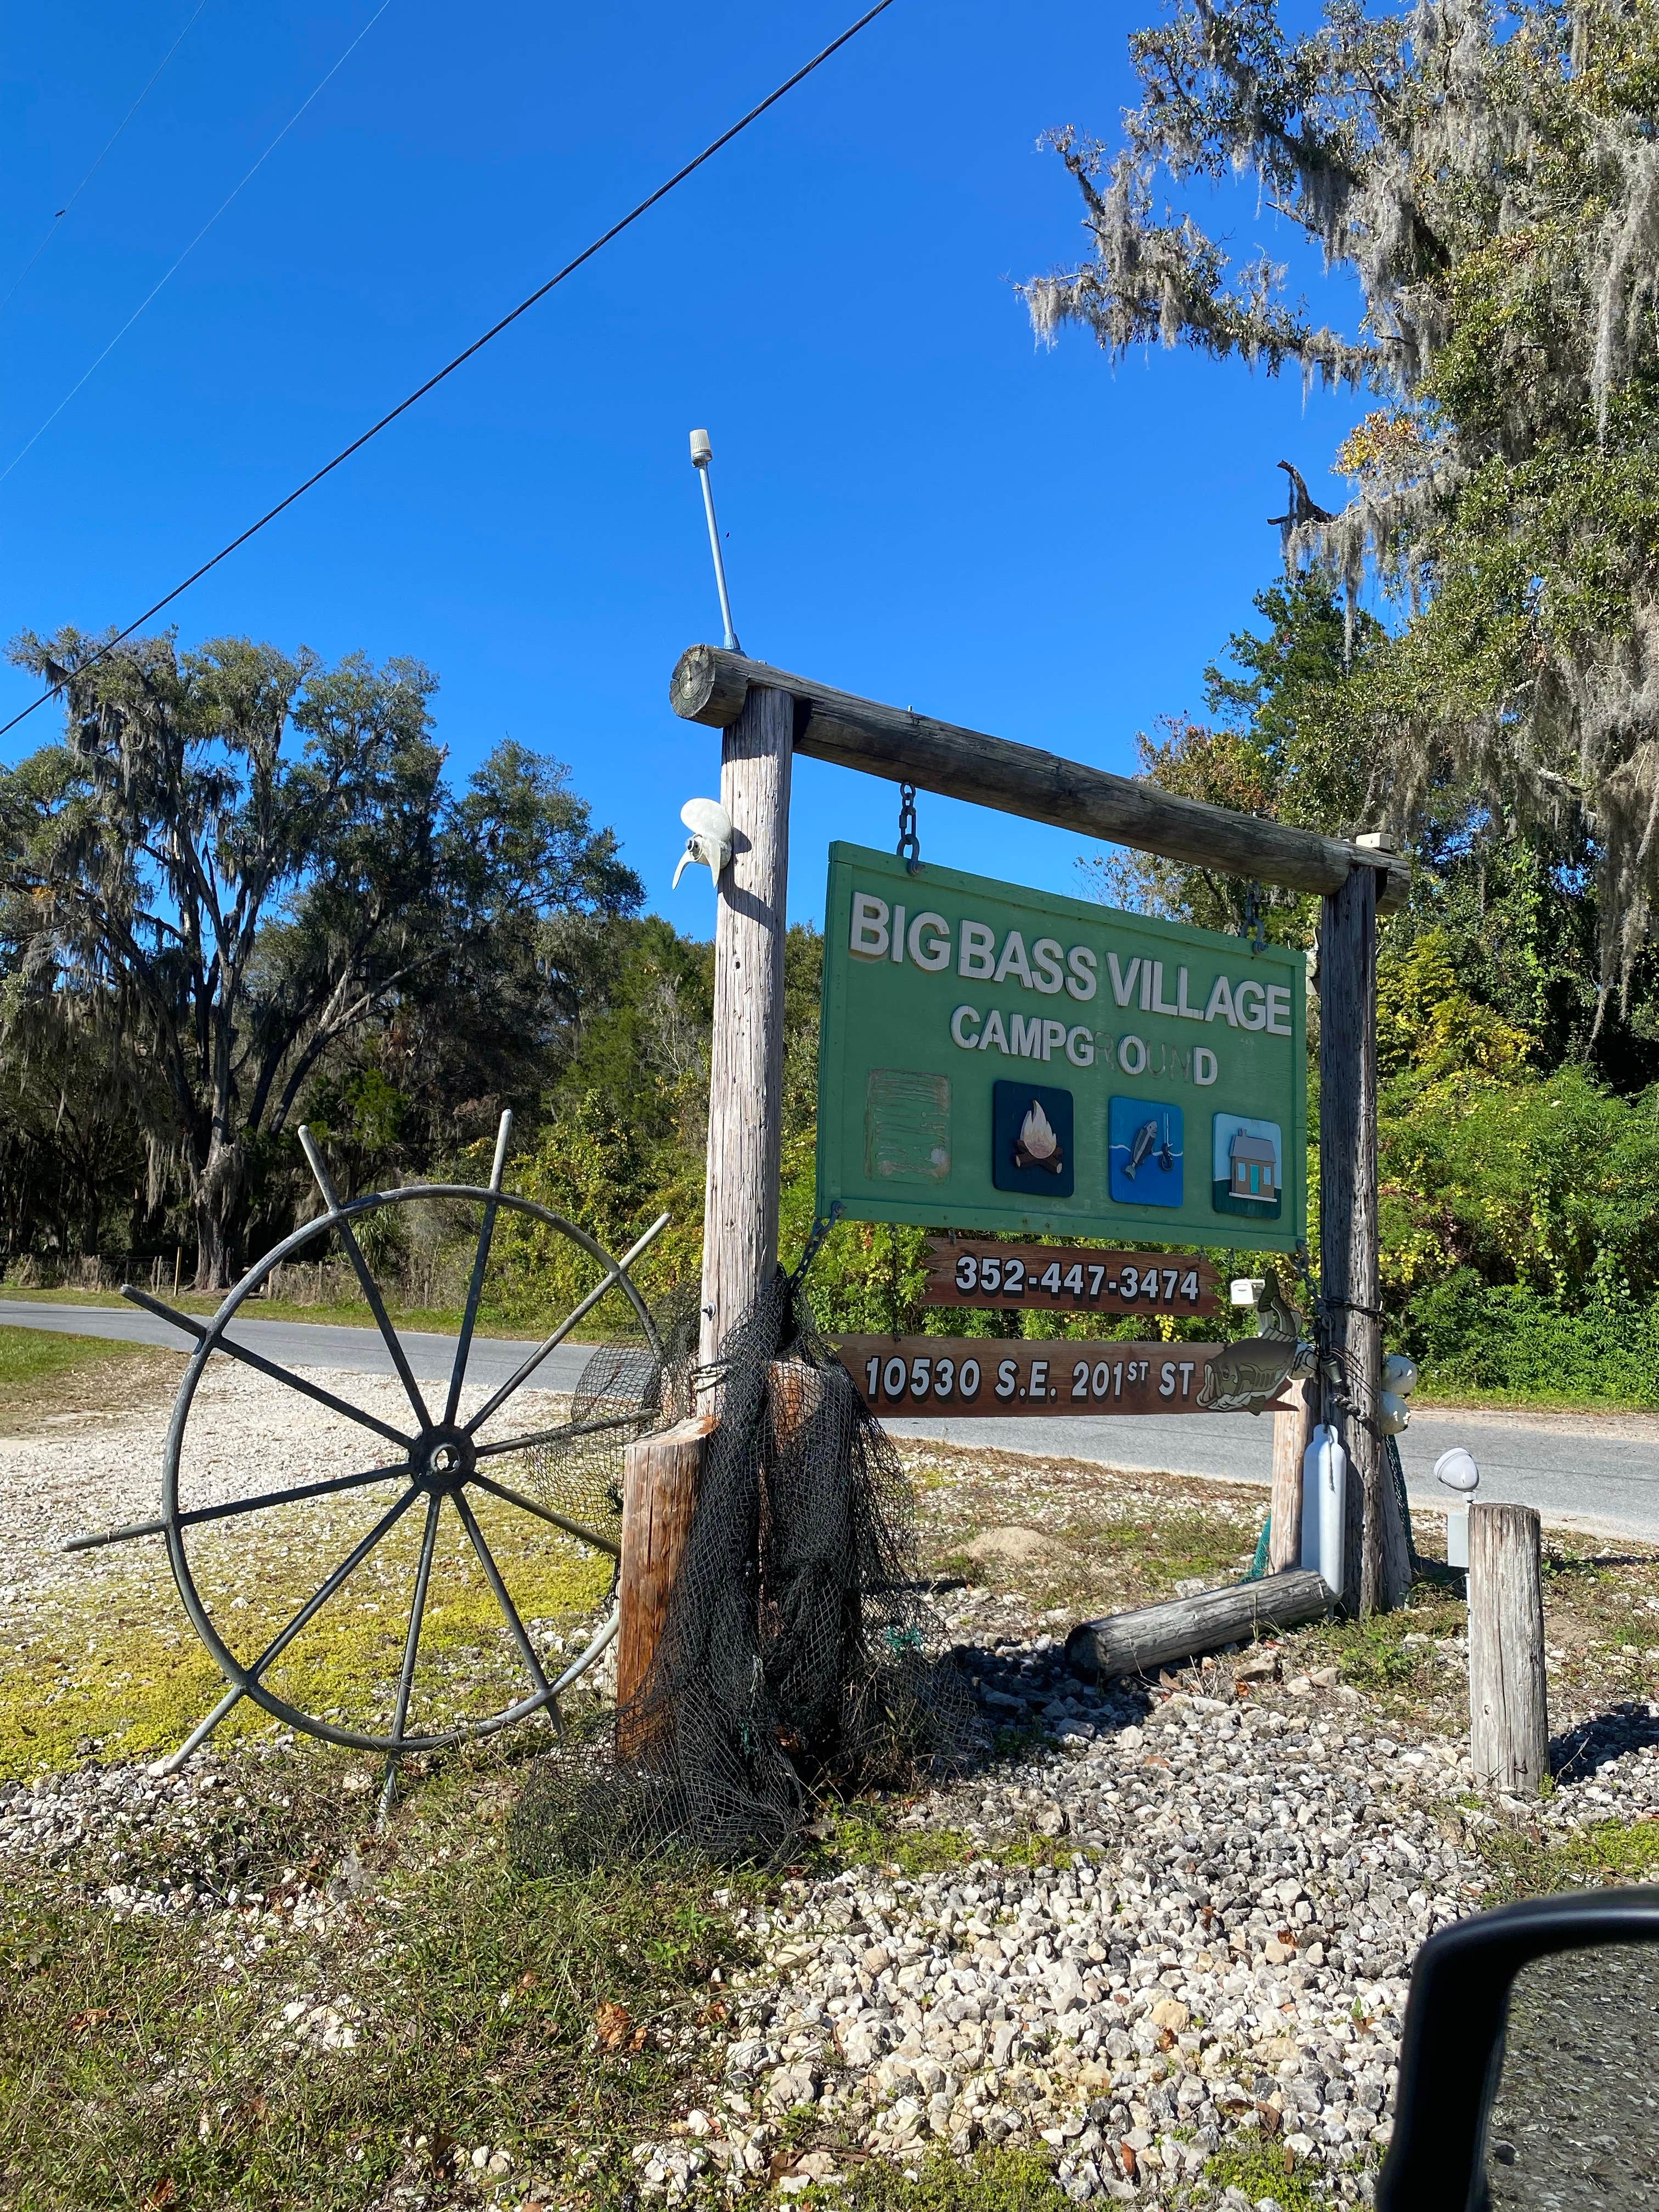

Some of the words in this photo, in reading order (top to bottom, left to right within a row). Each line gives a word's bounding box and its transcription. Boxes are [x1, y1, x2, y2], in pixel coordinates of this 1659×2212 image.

[849, 890, 951, 971] BIG
[957, 918, 1097, 1001] BASS
[1106, 951, 1292, 1036] VILLAGE
[955, 1256, 1199, 1300] 352-447-3474
[865, 1355, 980, 1397] 10530
[995, 1359, 1057, 1397] S.E.
[1159, 1362, 1194, 1396] ST
